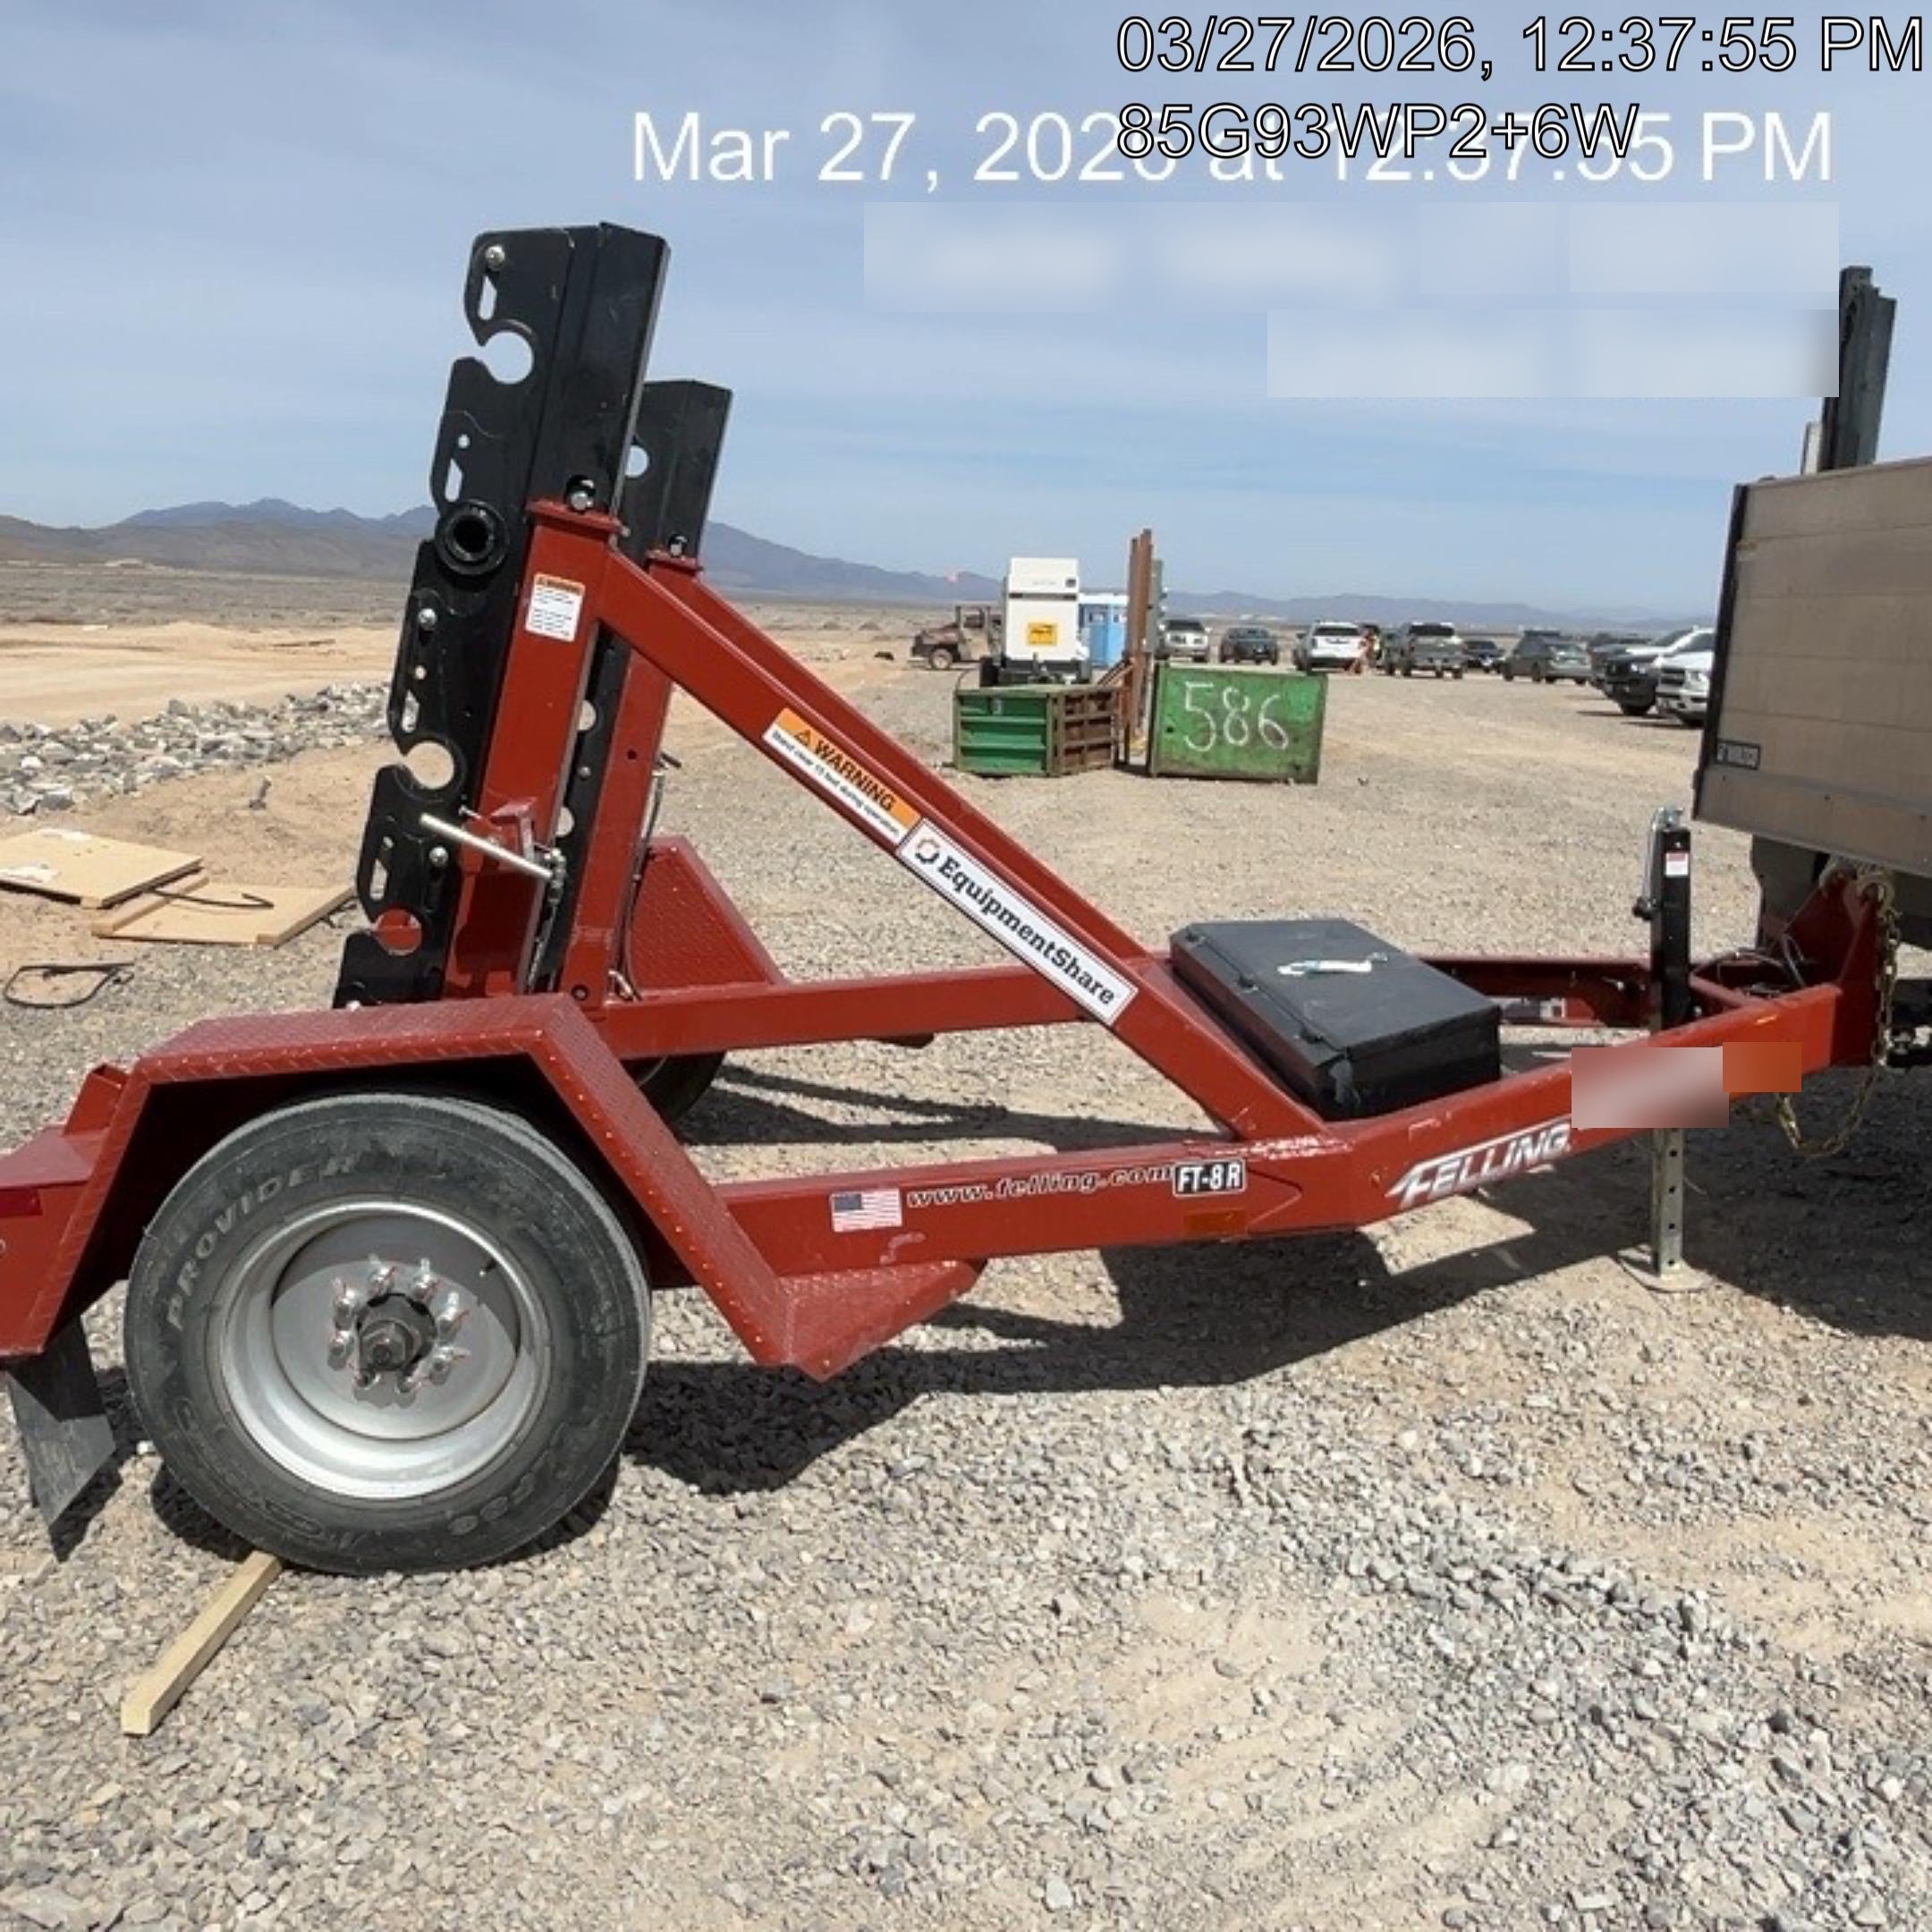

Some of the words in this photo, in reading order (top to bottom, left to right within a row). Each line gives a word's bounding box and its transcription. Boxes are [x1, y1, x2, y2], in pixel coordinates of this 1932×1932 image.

[1184, 681, 1290, 752] 586
[815, 739, 896, 811] WARNING
[938, 855, 1115, 1005] EquipmentShare
[907, 1165, 1174, 1208] www.felling.com
[1385, 1114, 1572, 1209] FELLING
